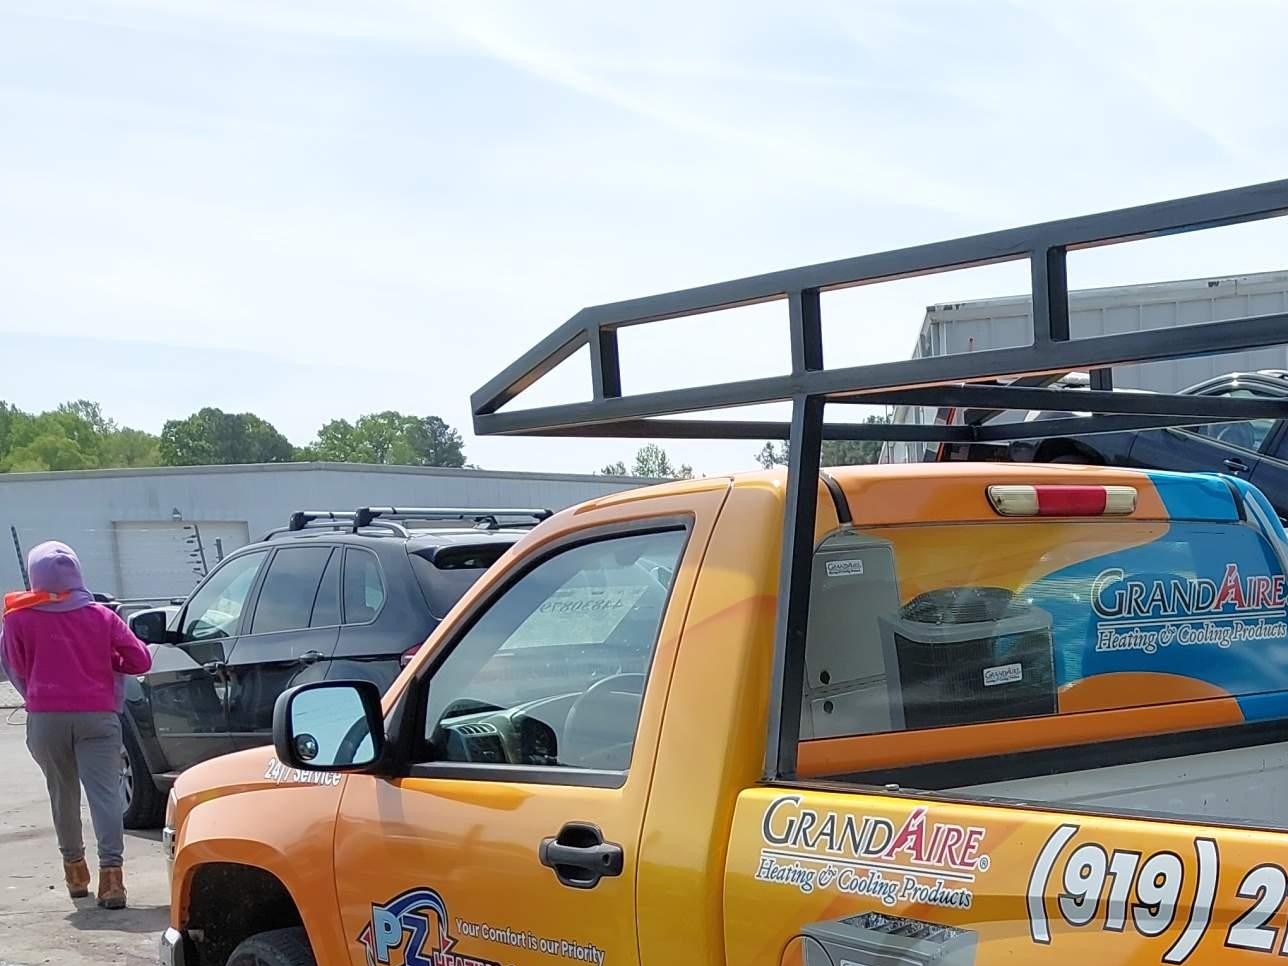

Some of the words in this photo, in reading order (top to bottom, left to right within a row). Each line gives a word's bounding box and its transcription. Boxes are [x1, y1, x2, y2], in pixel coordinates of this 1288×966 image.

[1091, 564, 1286, 618] GRANDAIRE
[1096, 627, 1156, 653] Heating
[1159, 624, 1177, 647] &
[1178, 622, 1231, 647] Cooling
[1233, 619, 1286, 641] Products
[762, 796, 986, 869] GRANDAIRE
[756, 857, 815, 891] Heating
[818, 865, 837, 886] &
[838, 869, 897, 905] Cooling
[900, 877, 972, 909] Products
[1027, 824, 1220, 965] (919)
[456, 918, 479, 938] Your
[481, 925, 526, 947] Comfort
[528, 932, 538, 949] is
[540, 938, 560, 955] our
